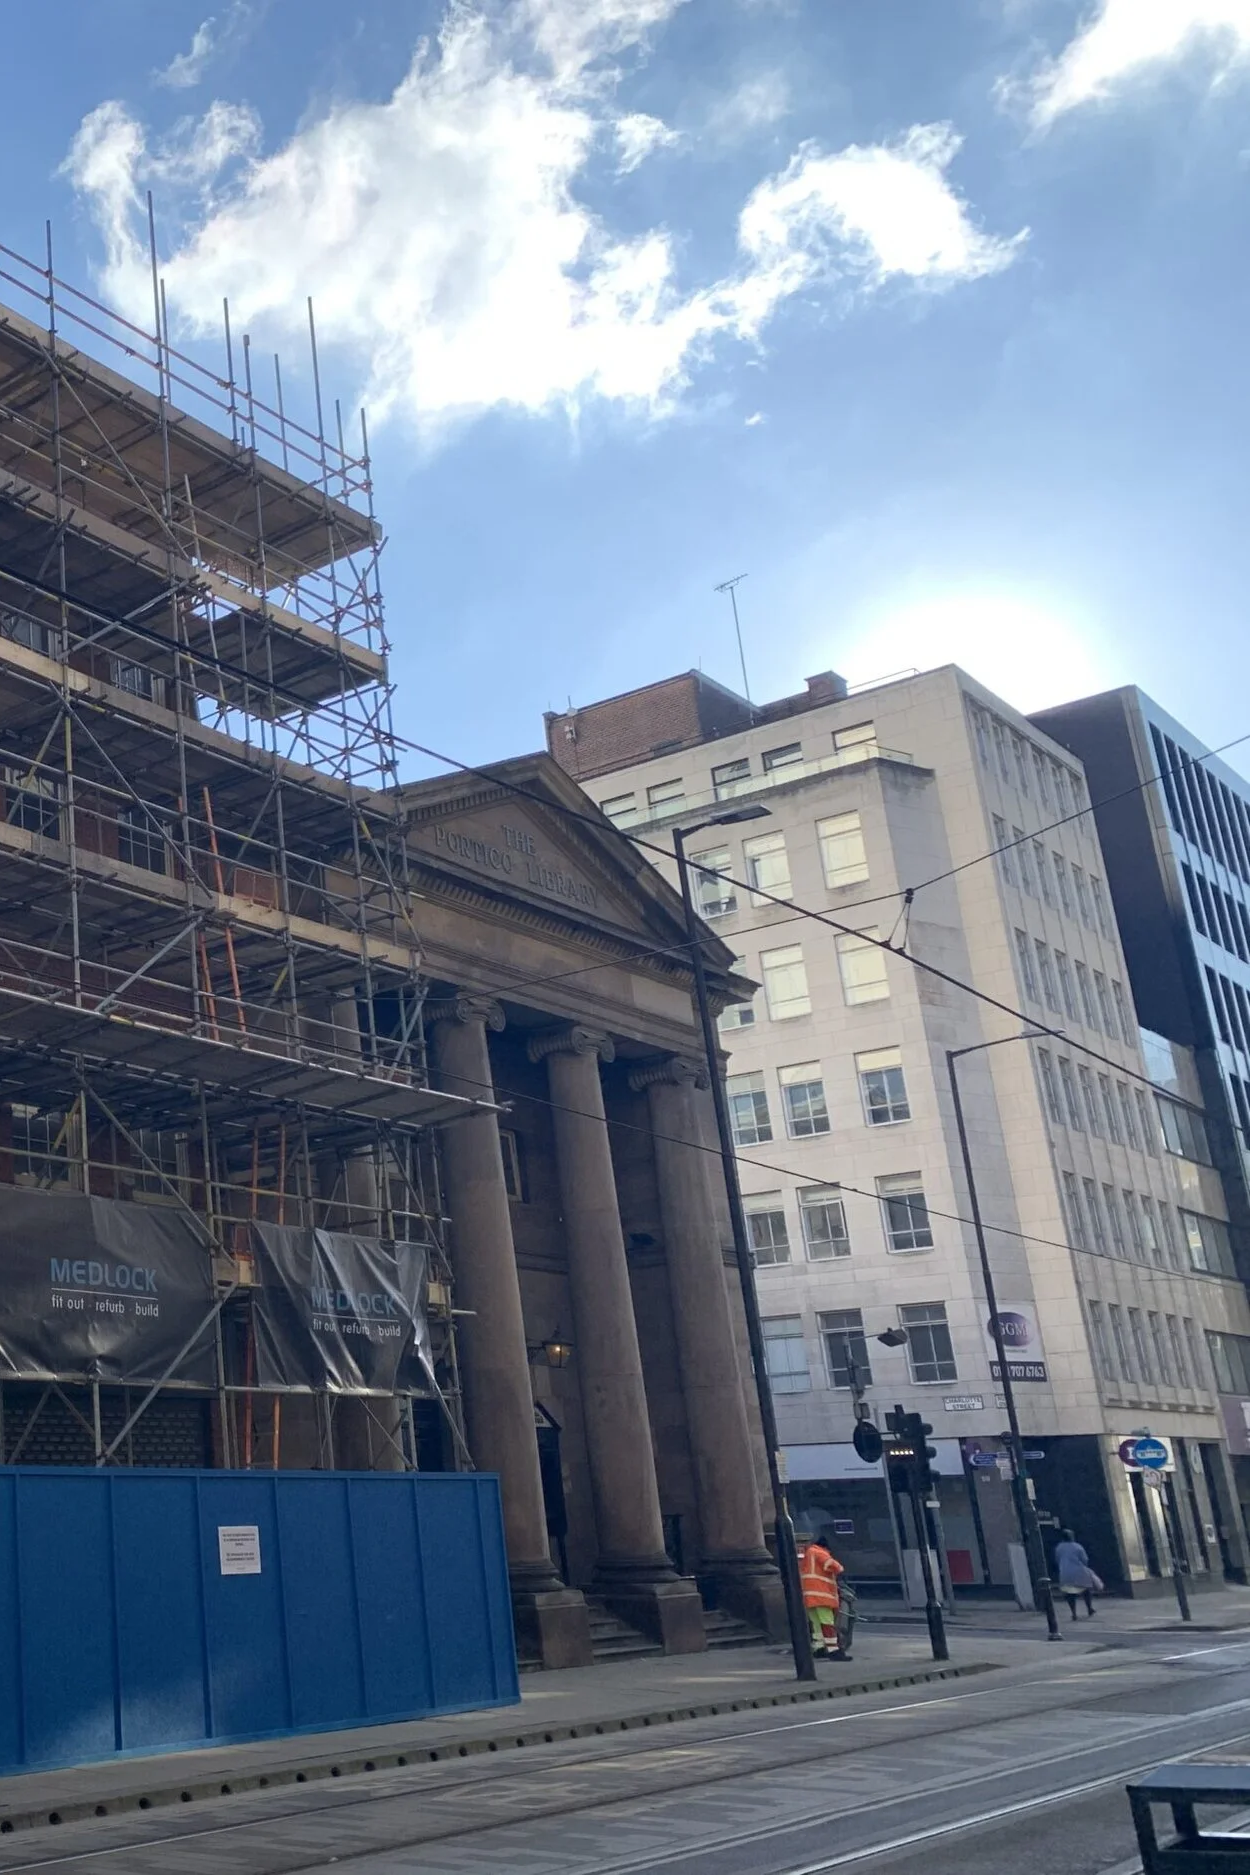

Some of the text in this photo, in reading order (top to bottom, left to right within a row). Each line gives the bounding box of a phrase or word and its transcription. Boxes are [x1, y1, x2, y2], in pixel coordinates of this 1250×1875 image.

[502, 825, 538, 857] THE
[434, 823, 601, 909] PORTICO LIBRARY
[50, 1256, 158, 1293] MEDLOCK
[51, 1294, 159, 1317] fit out refurb build
[310, 1286, 398, 1316] MEDOCK
[313, 1318, 322, 1330] fit
[377, 1325, 401, 1337] build
